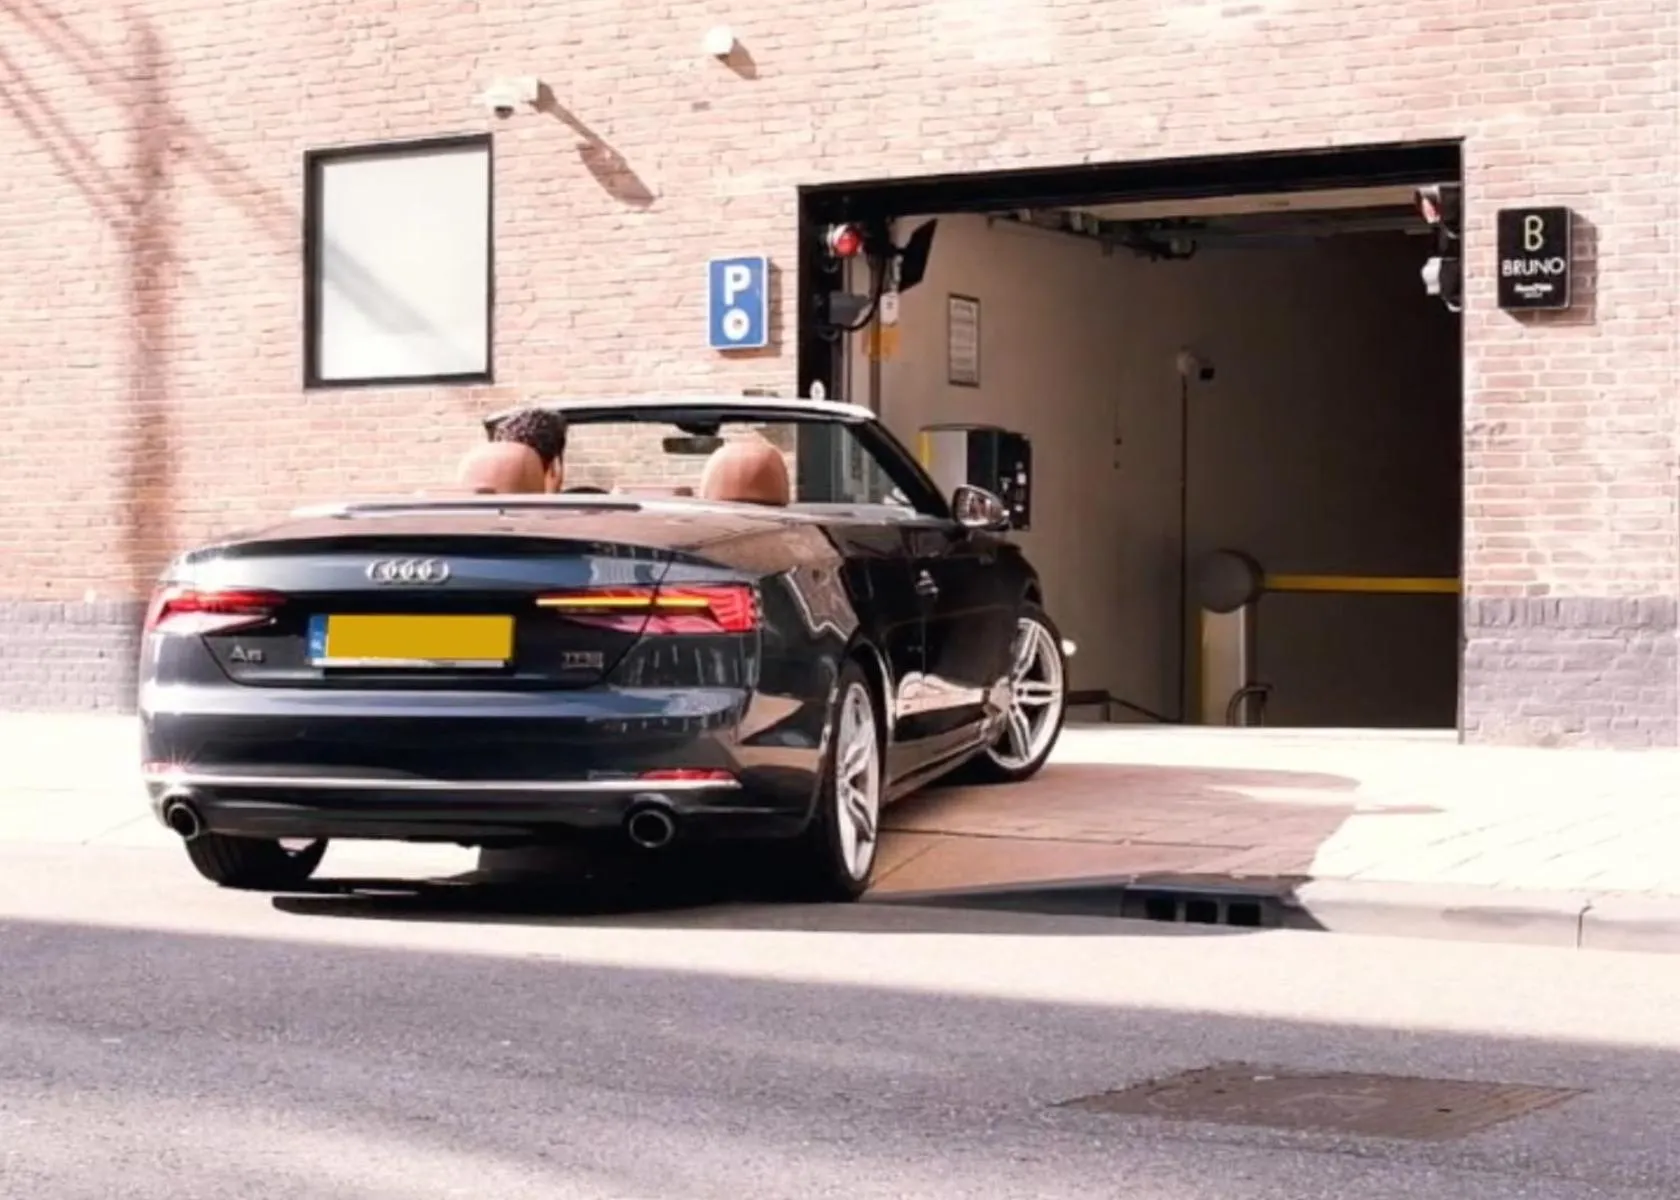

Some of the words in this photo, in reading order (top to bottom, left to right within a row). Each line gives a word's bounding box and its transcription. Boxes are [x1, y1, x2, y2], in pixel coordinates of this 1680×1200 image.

[1524, 214, 1544, 251] B
[724, 265, 751, 306] P
[1502, 257, 1565, 277] BRUNO
